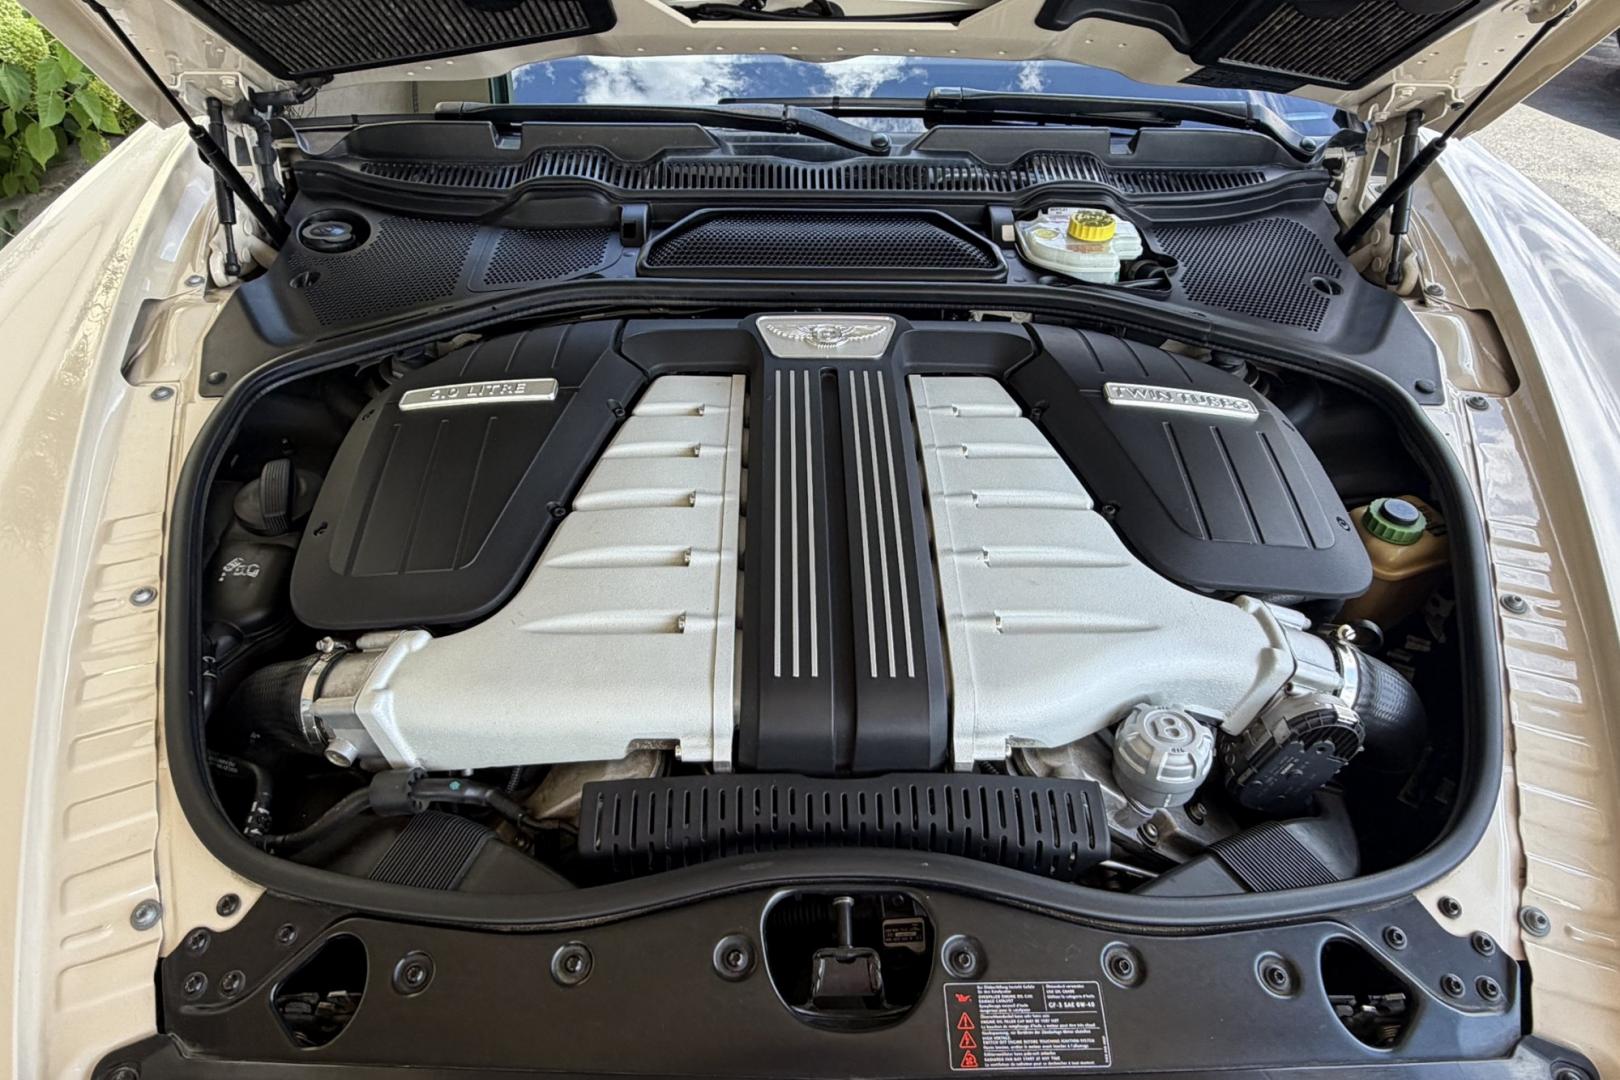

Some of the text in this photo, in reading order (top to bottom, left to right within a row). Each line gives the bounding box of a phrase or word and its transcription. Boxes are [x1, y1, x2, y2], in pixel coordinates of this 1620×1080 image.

[467, 383, 527, 397] LITRE
[1112, 386, 1249, 411] TWIN TURBO
